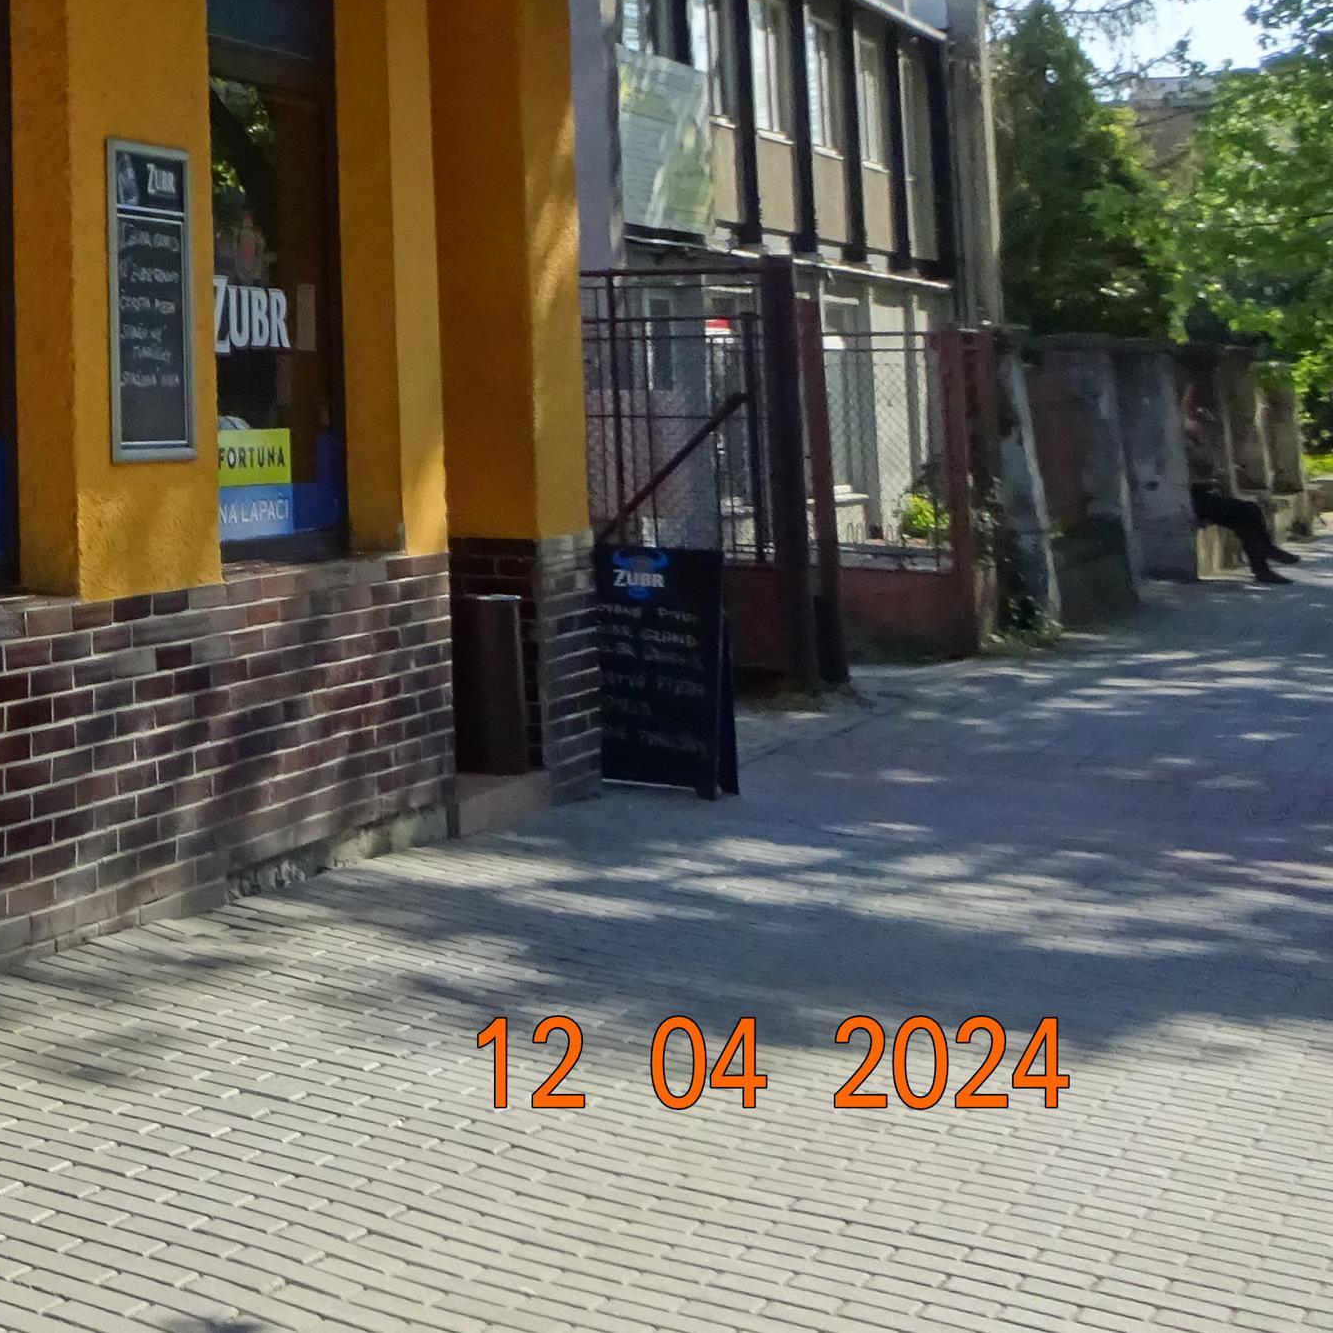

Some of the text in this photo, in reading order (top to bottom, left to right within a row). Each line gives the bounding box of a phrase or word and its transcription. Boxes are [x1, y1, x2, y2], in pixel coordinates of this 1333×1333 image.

[213, 275, 291, 354] ZUBR
[218, 446, 285, 469] FORTUNA
[218, 491, 289, 525] NA LAPAČI
[613, 569, 665, 587] ZUBR
